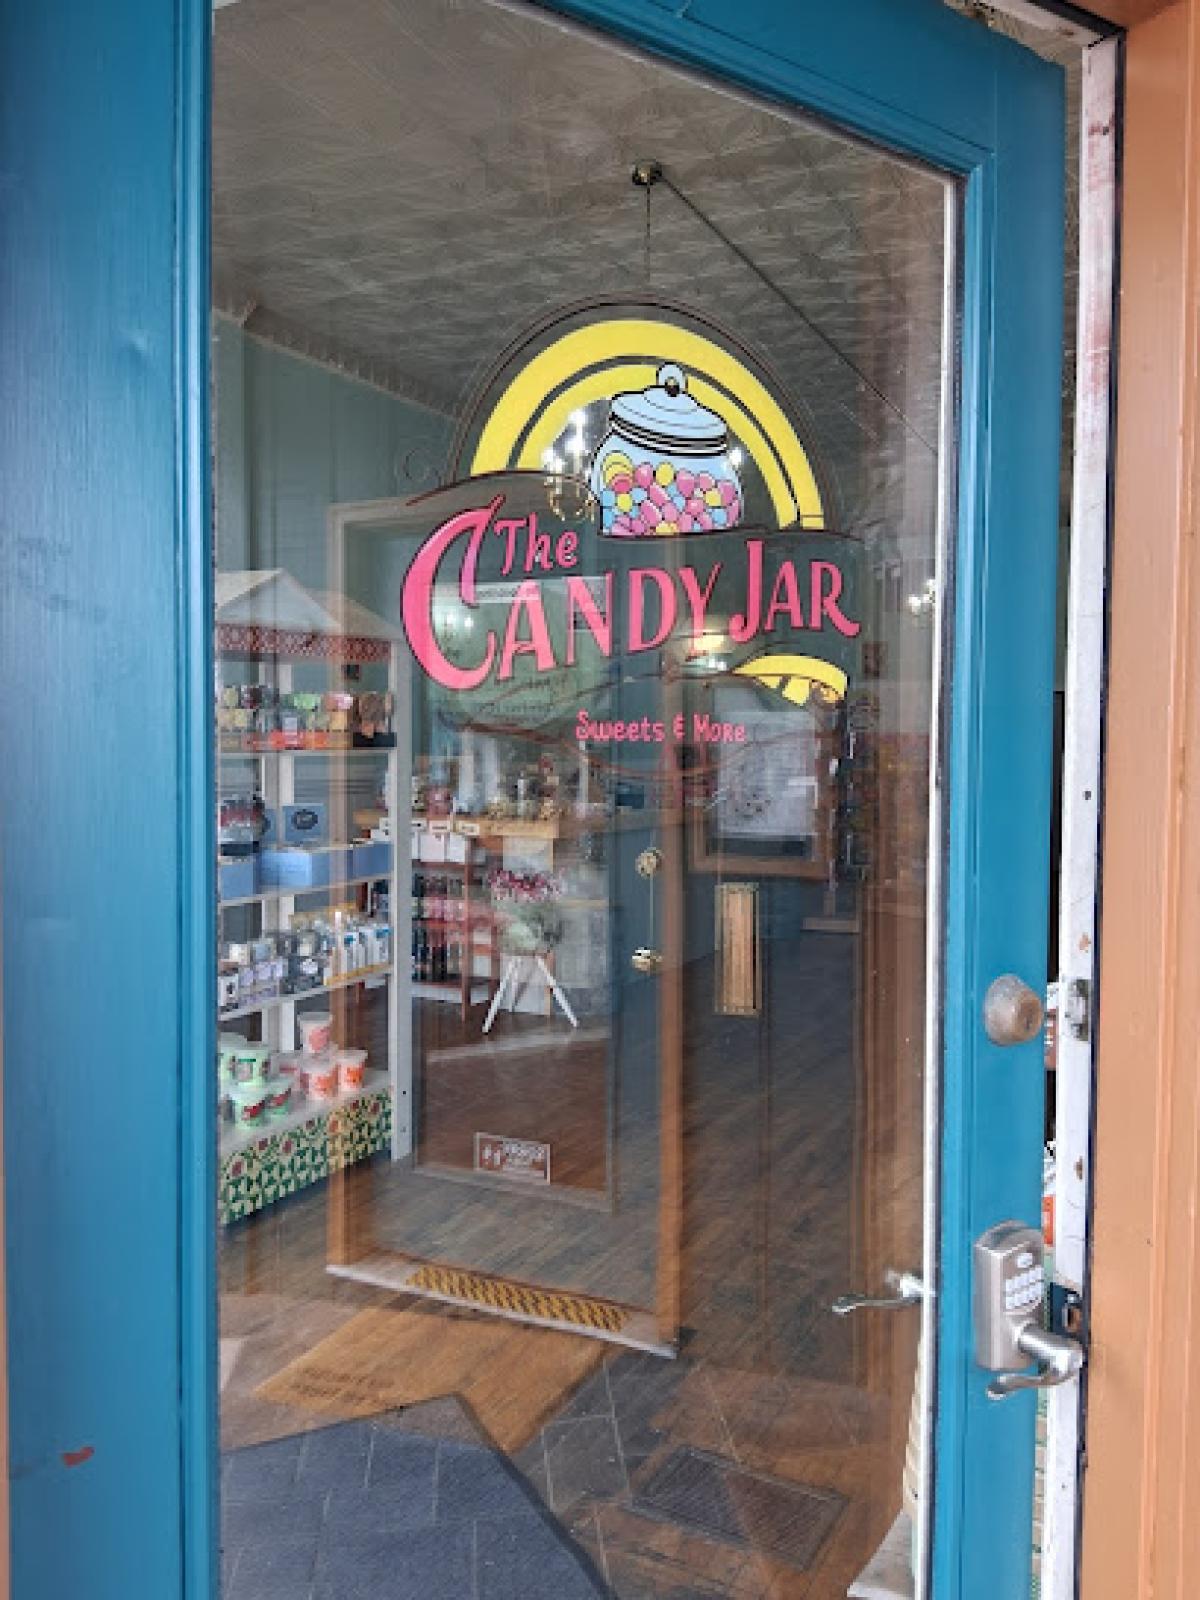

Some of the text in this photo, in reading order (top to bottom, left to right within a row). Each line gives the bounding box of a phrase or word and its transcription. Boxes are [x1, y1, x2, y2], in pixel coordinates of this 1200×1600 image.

[493, 511, 578, 576] The
[402, 494, 861, 691] CANDY JAR
[575, 707, 665, 742] Sweets
[673, 712, 685, 741] &
